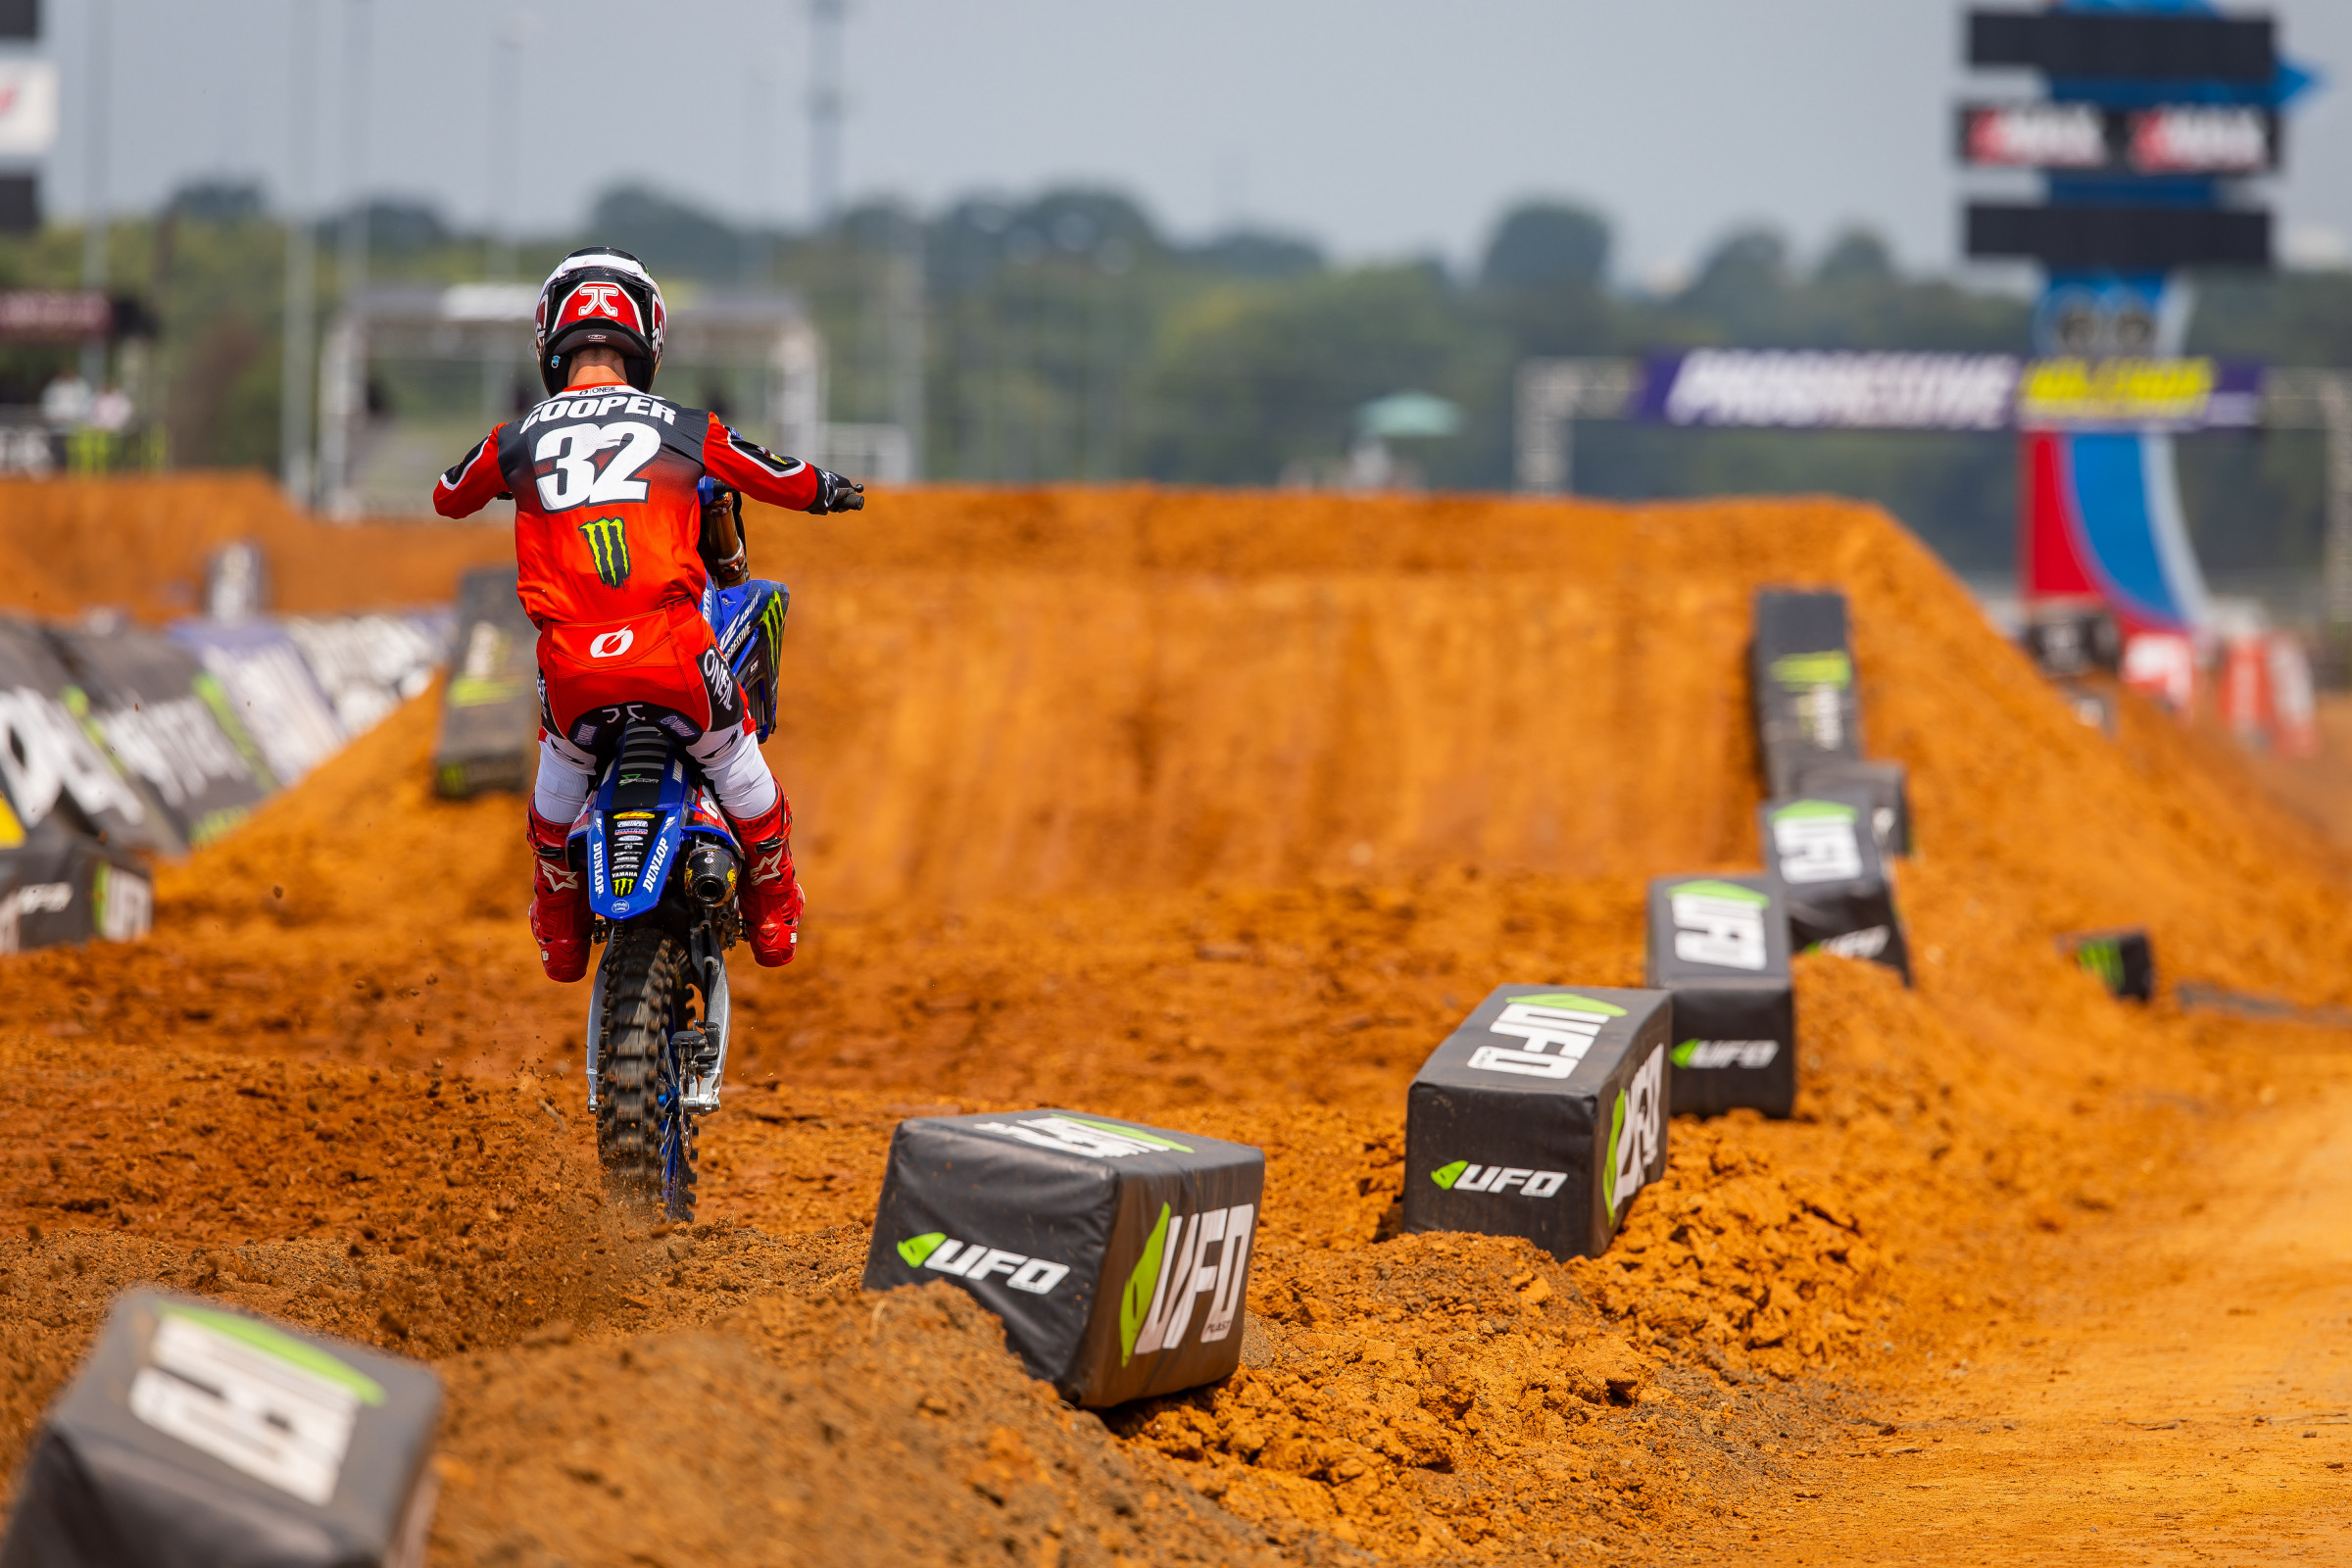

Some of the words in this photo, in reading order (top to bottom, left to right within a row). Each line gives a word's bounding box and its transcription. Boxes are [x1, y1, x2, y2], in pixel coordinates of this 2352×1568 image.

[519, 396, 677, 435] COOPER
[535, 421, 662, 511] 32
[593, 841, 605, 896] DUNLOP
[642, 837, 669, 894] DUNLOP
[1467, 1003, 1610, 1079] UFO
[1690, 1040, 1780, 1068] UFO
[1453, 1164, 1568, 1198] UFO
[924, 1239, 1070, 1296] UFO
[1135, 1203, 1254, 1355] UFO
